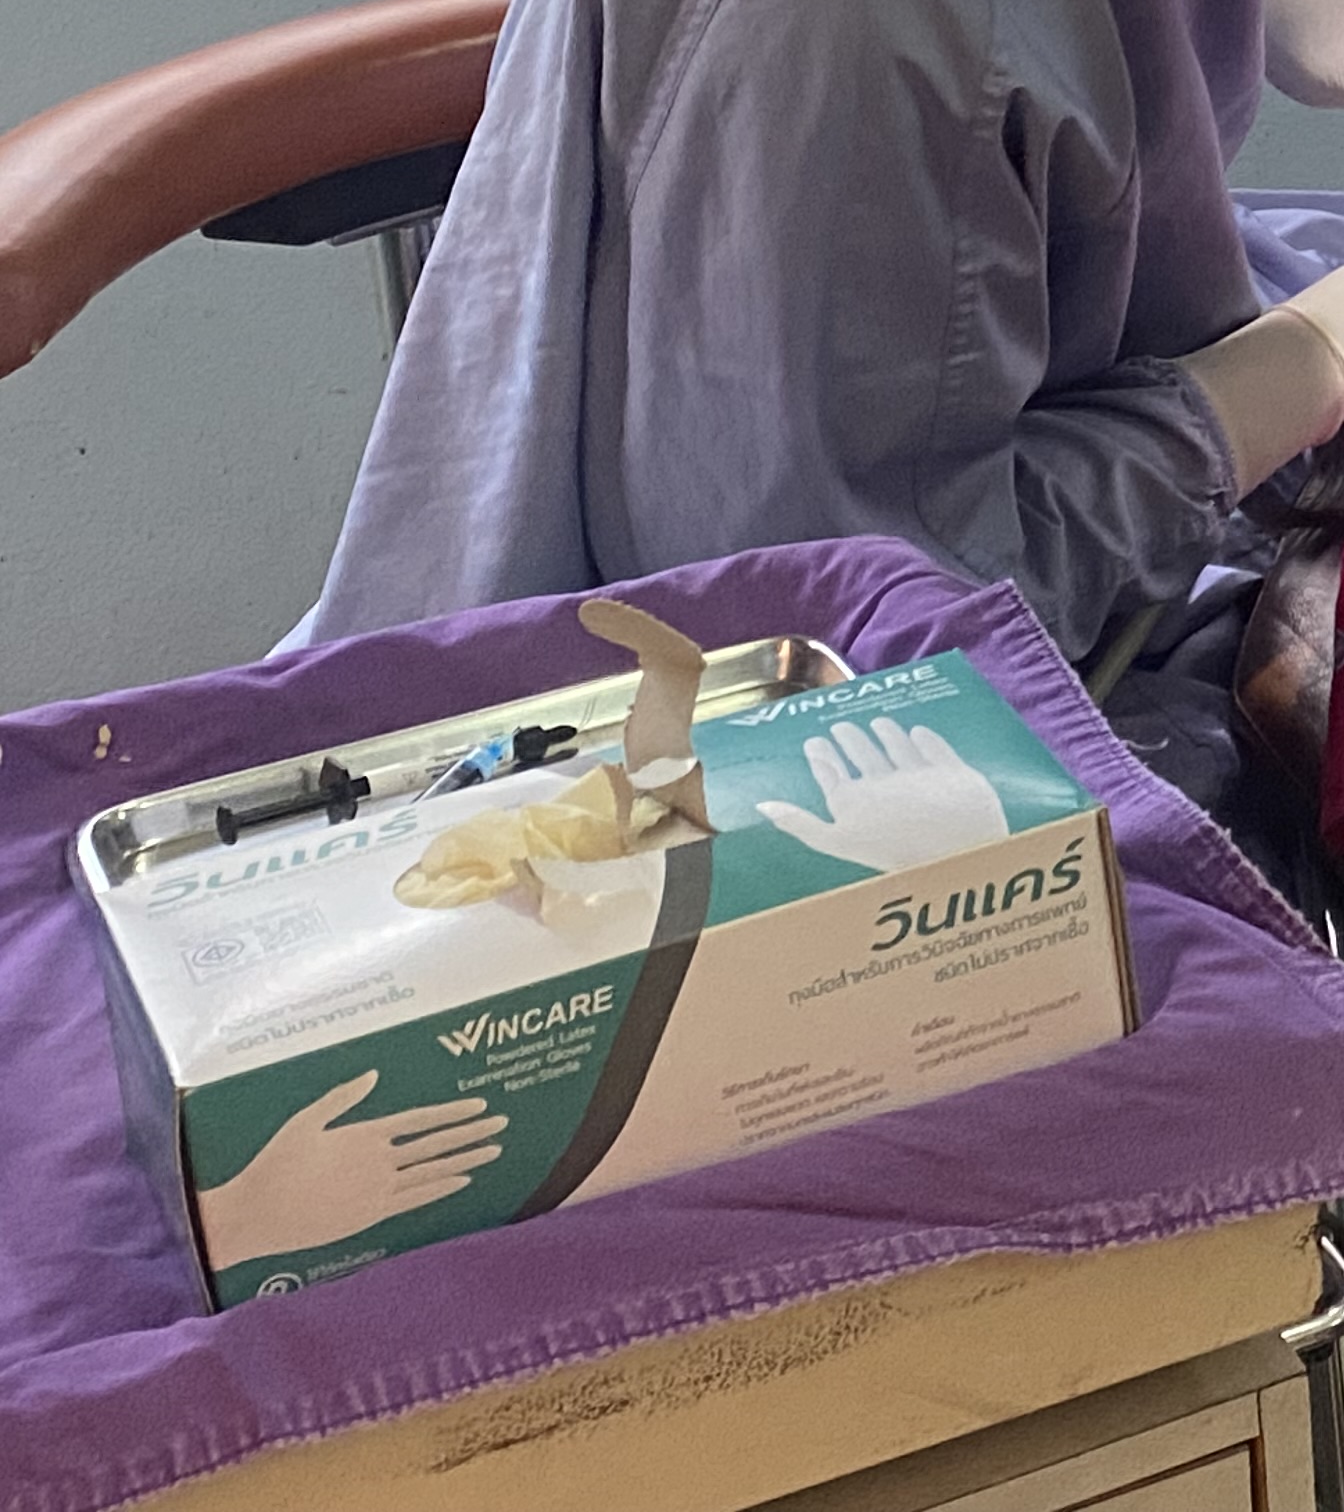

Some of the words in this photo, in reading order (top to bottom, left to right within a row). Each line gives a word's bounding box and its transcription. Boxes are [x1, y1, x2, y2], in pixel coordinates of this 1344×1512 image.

[726, 664, 939, 727] WINCARE
[147, 808, 419, 908] วินแคร์
[871, 836, 1086, 951] วินแคร์
[437, 985, 615, 1057] WINCARE
